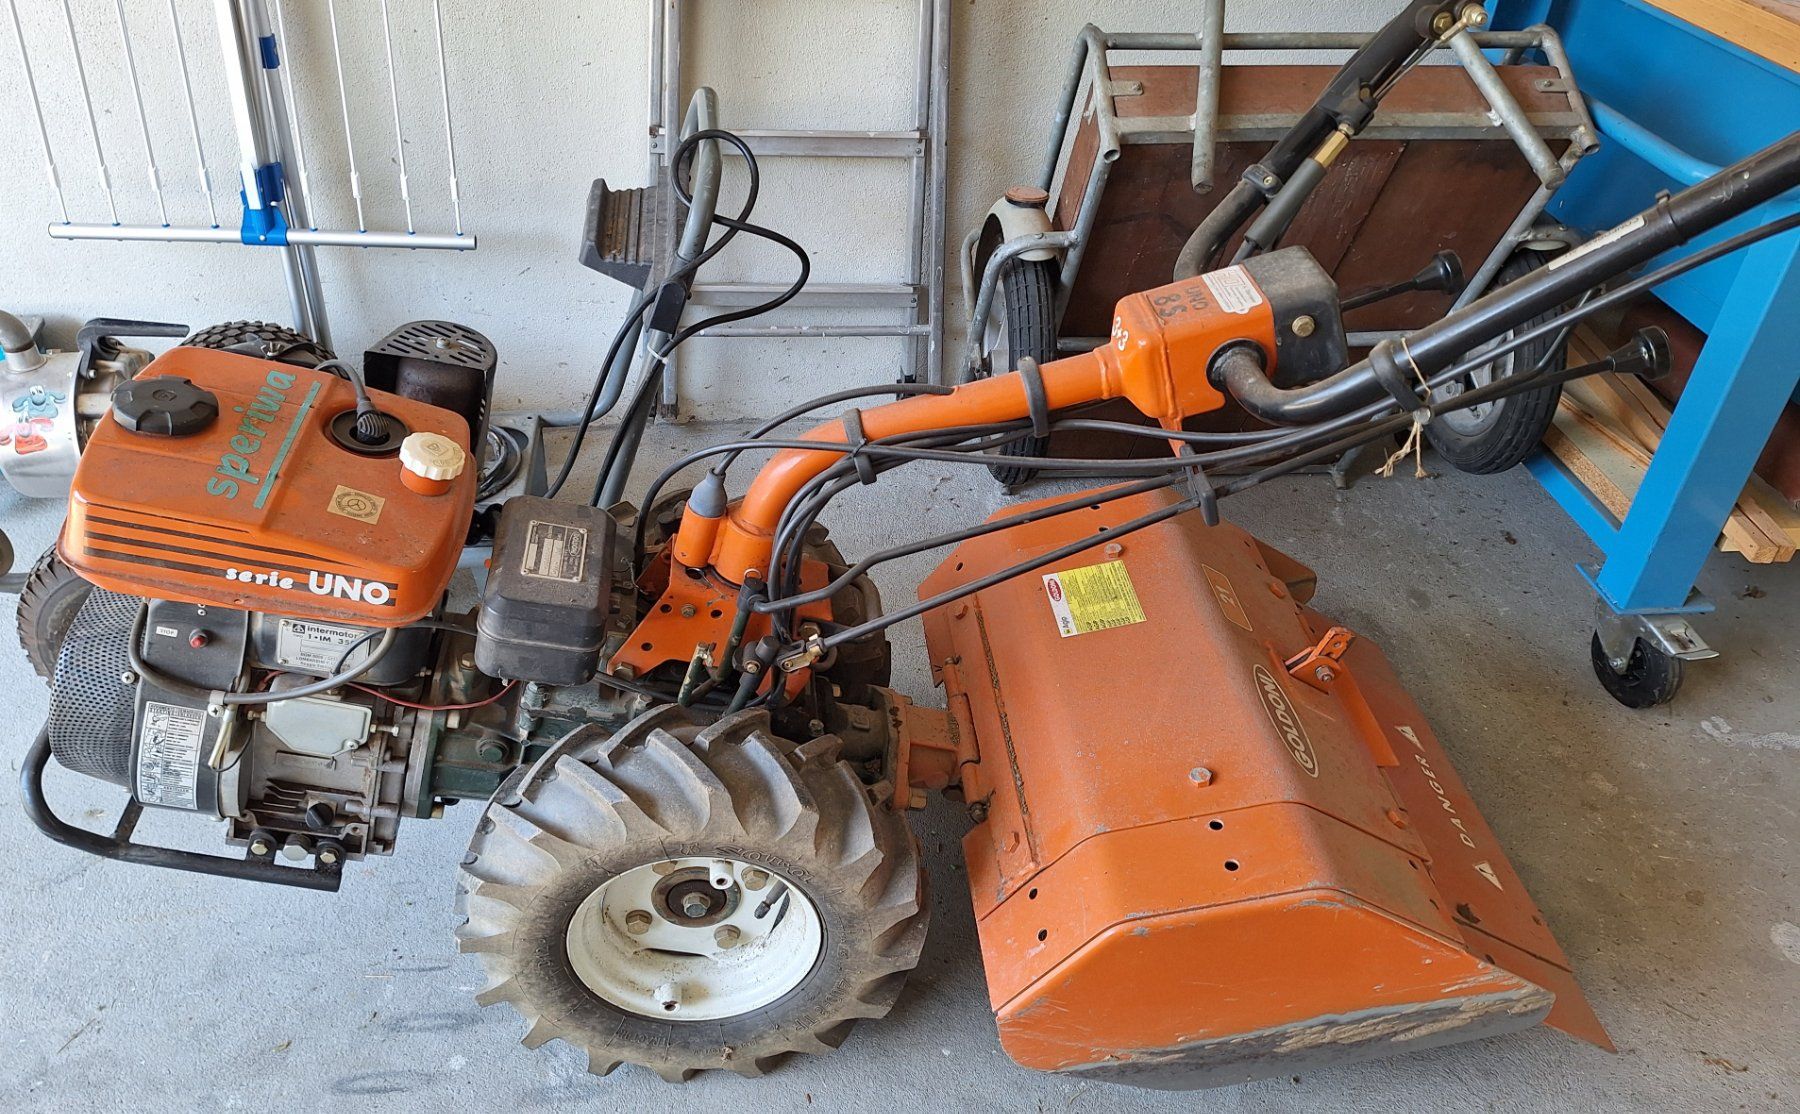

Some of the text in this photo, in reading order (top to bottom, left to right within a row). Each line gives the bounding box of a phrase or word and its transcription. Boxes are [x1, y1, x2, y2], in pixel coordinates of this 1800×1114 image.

[206, 369, 296, 500] speriwa
[224, 568, 390, 605] serie UNO
[307, 626, 358, 639] intermotor
[1257, 672, 1314, 769] GOLDONI
[1414, 753, 1476, 849] DANGER
